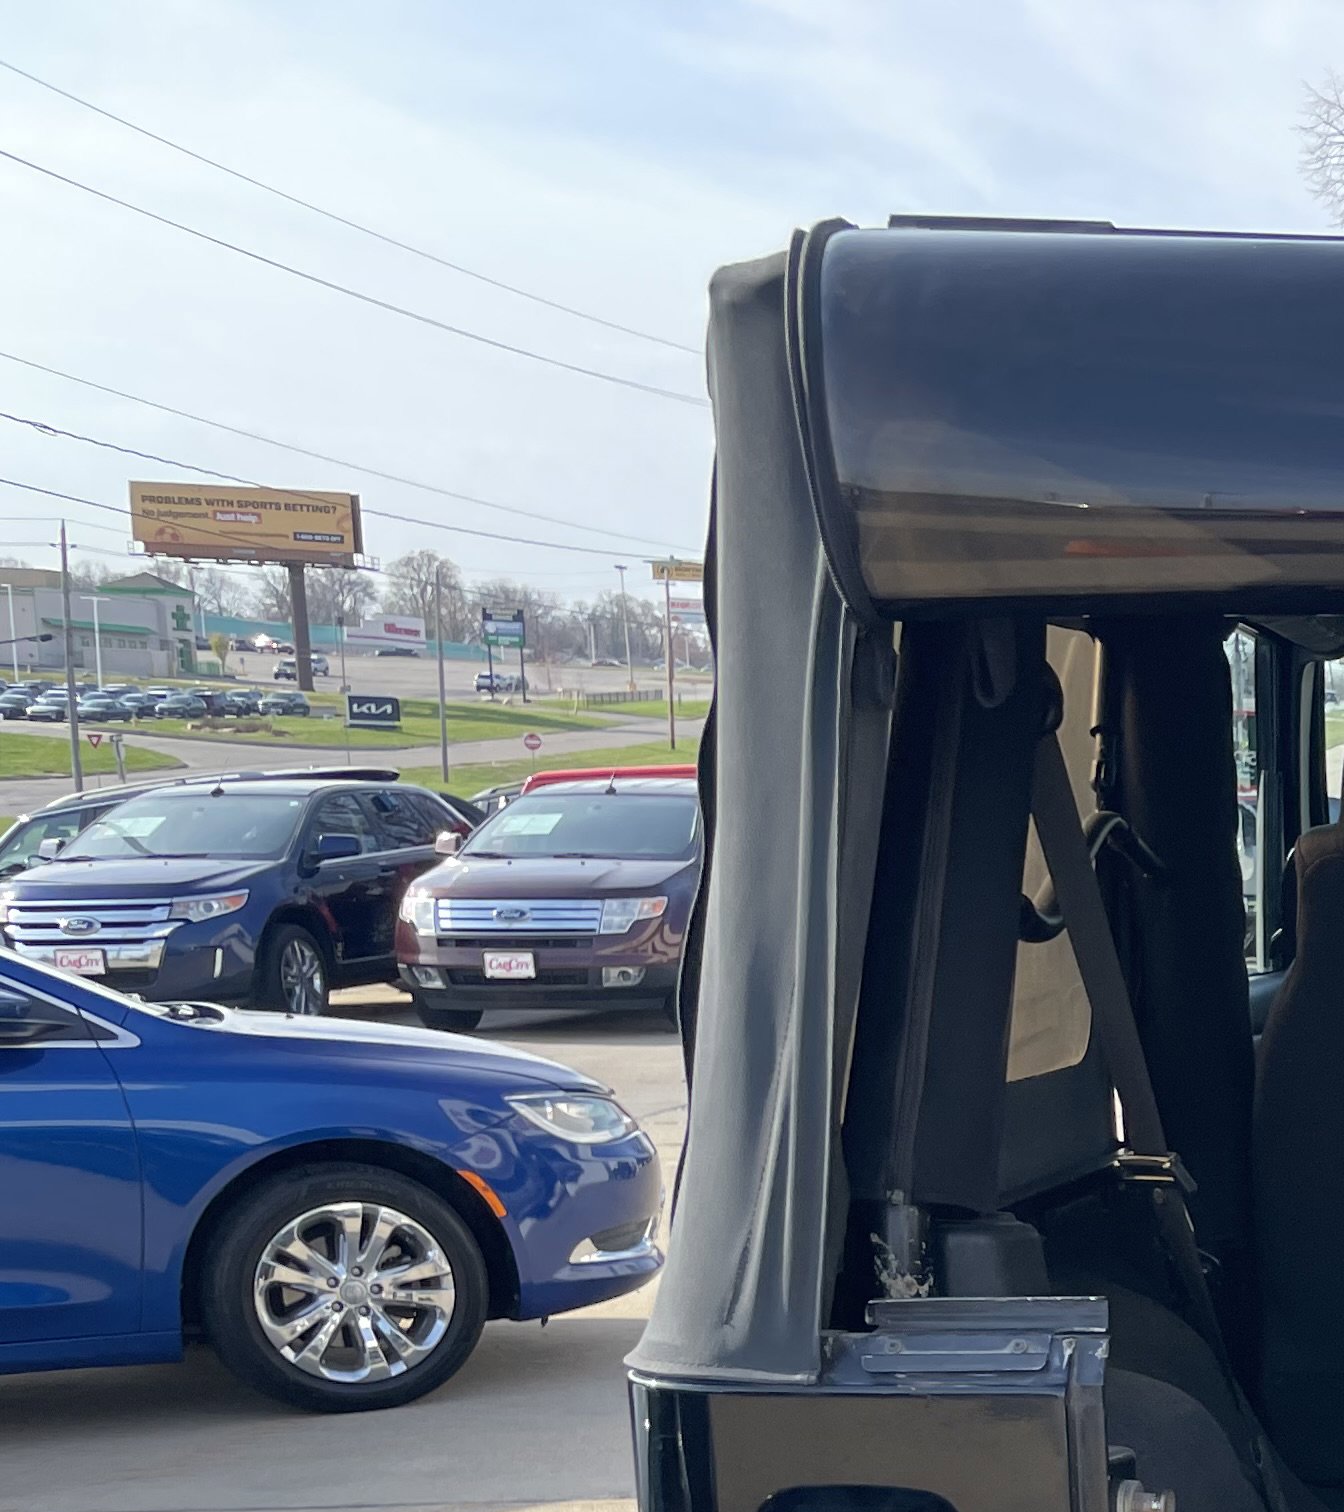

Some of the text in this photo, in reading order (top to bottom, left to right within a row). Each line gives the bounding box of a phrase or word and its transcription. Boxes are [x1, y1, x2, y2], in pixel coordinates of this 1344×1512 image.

[141, 495, 337, 514] PROBLEMS WITH SPORTS BETTING?
[142, 509, 156, 517] No
[216, 512, 236, 521] Just
[352, 703, 393, 715] KIA
